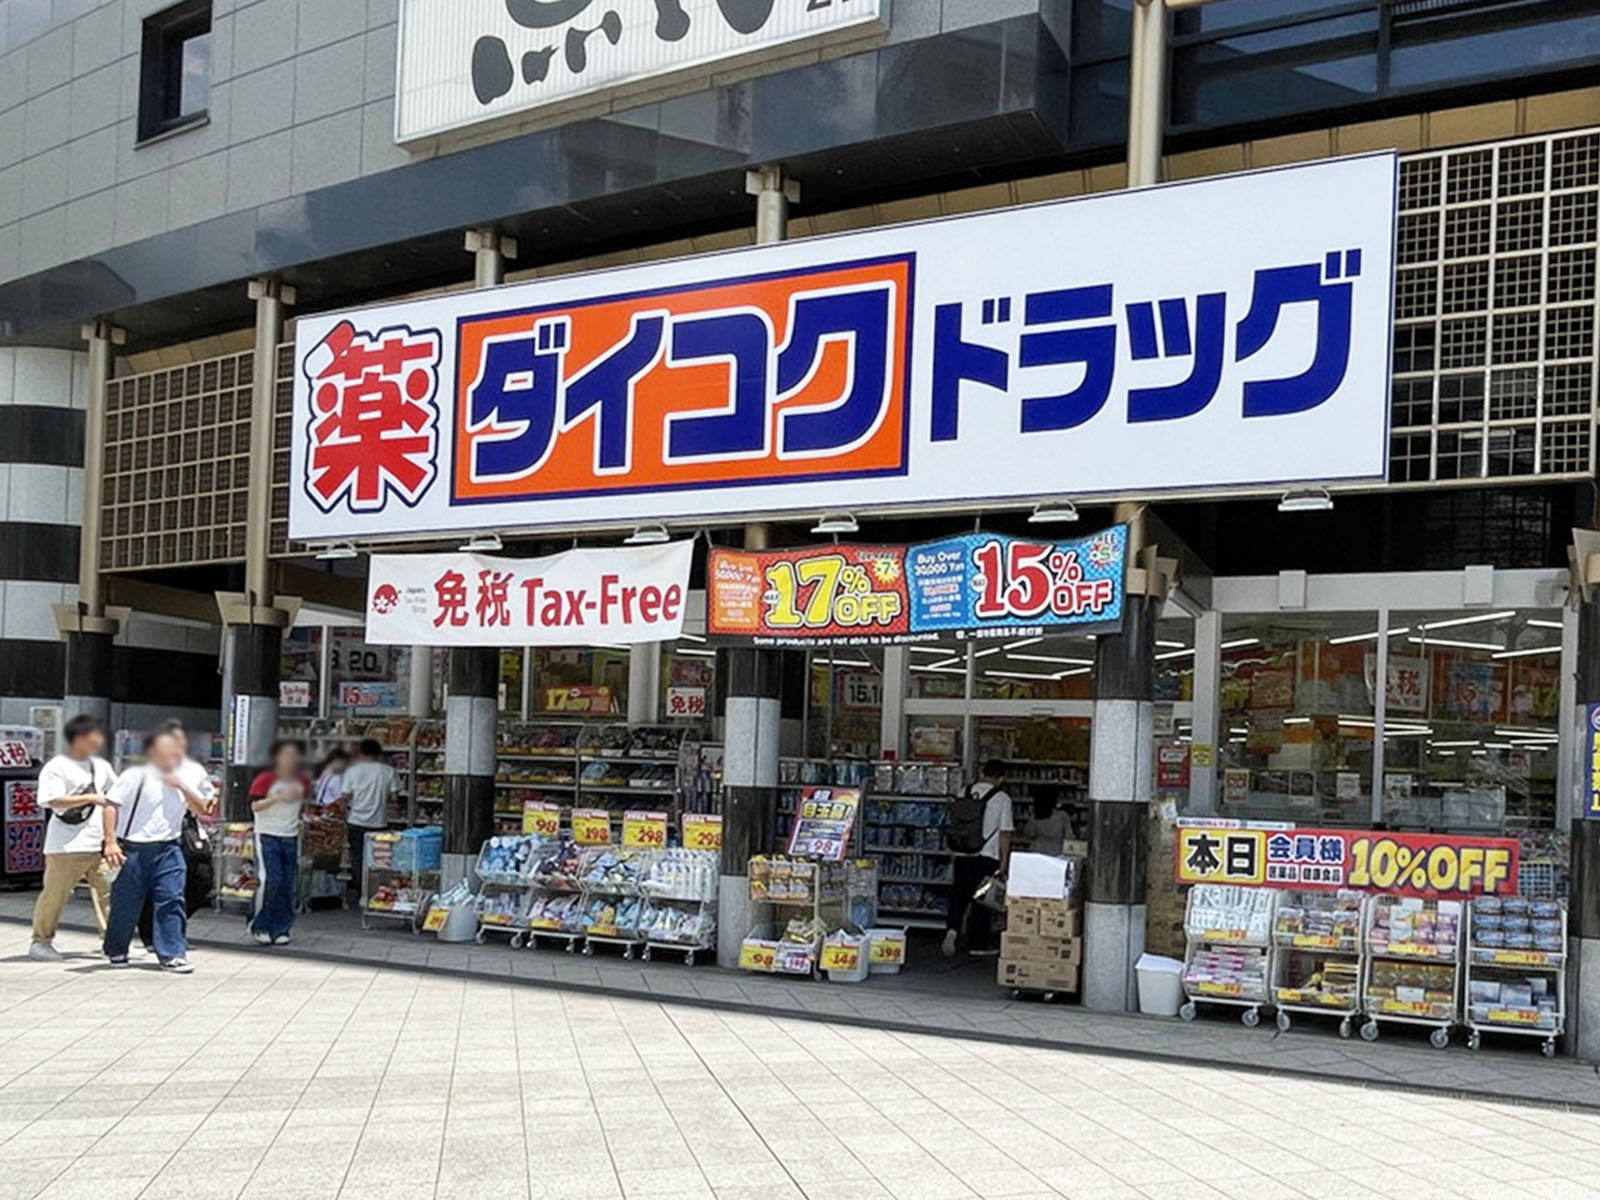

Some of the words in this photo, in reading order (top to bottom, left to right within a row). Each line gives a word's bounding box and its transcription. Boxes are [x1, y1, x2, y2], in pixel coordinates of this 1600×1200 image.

[308, 320, 440, 508] 薬
[468, 287, 892, 478] ダイコク
[930, 248, 1362, 443] ドラッグ
[433, 569, 515, 628] 免税
[520, 574, 682, 627] Tax-Free
[1053, 581, 1112, 613] OFF
[835, 595, 899, 624] OFF
[535, 818, 557, 834] 98
[584, 827, 609, 841] 198
[637, 826, 663, 843] 298
[697, 831, 722, 846] 298
[1185, 832, 1257, 878] 本日
[1268, 835, 1343, 862] 会員様
[1348, 838, 1509, 894] 10%OFF
[752, 952, 774, 966] 98
[832, 951, 858, 965] 148
